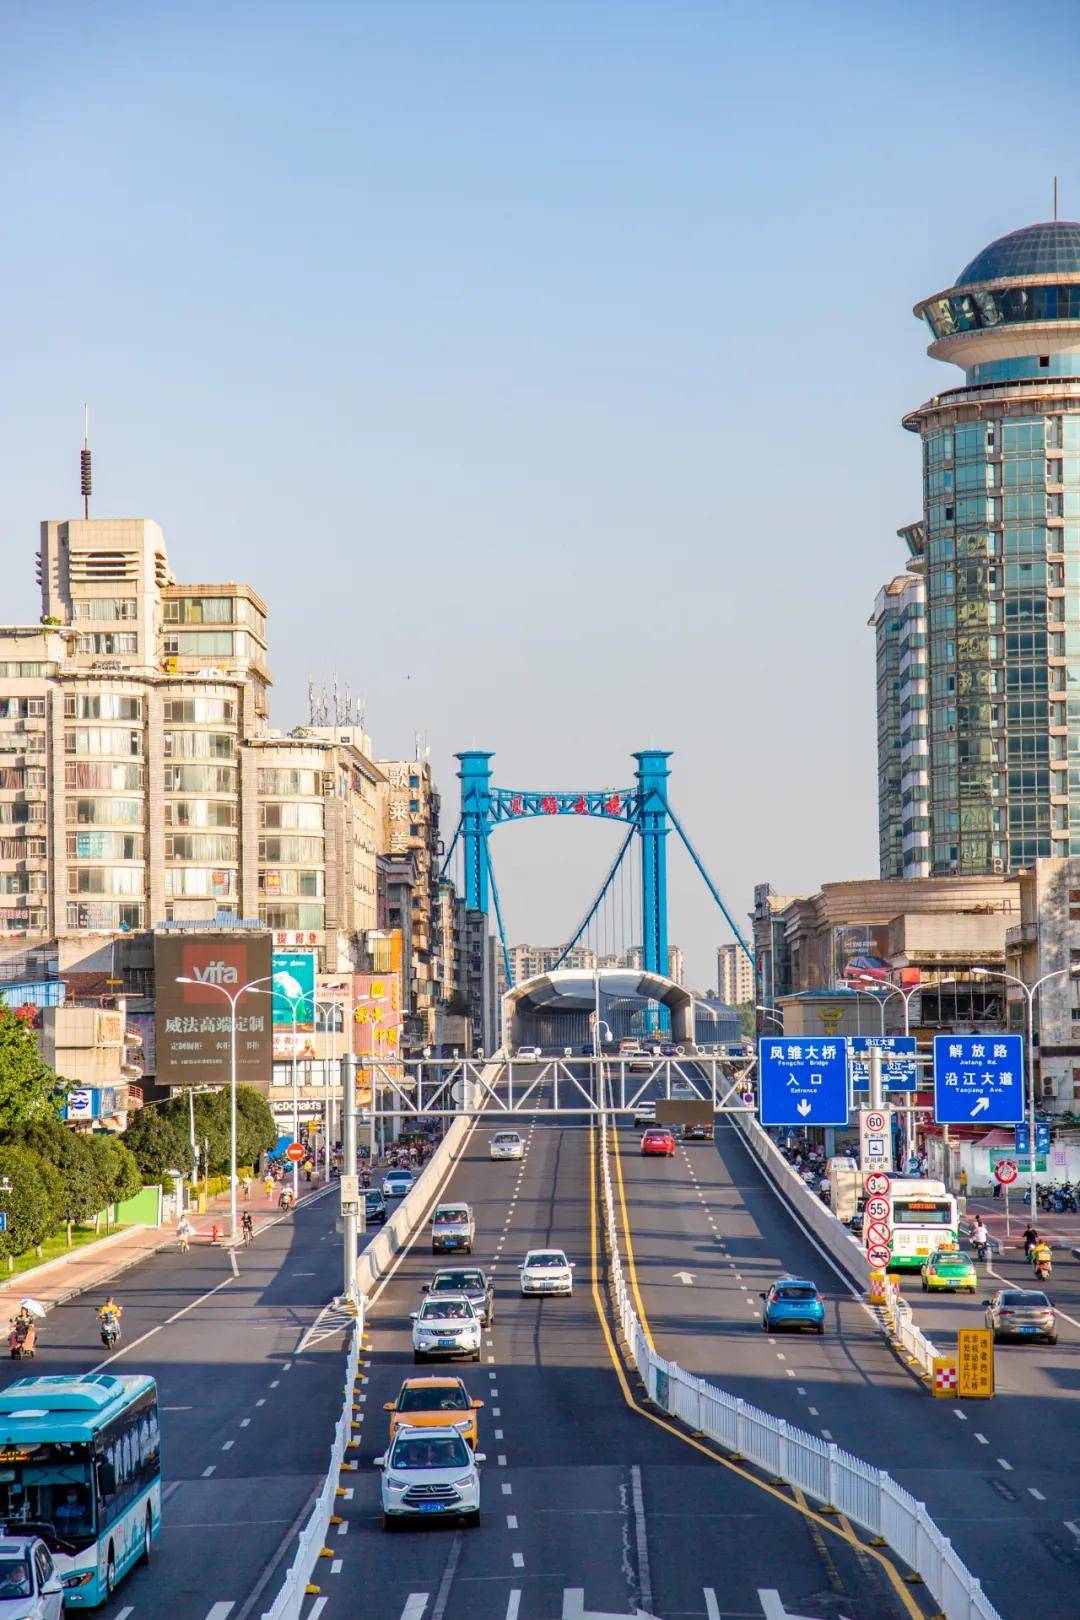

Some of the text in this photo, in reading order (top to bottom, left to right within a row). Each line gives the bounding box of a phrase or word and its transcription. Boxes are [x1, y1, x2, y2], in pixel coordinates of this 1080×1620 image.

[388, 767, 408, 853] 歌莱美
[192, 961, 238, 983] vifa
[165, 1016, 264, 1033] 威法高端定制
[865, 1038, 896, 1047] 沿江大道
[769, 1044, 837, 1060] 凤雏大桥
[949, 1043, 1008, 1058] 解放路
[786, 1072, 822, 1086] 入口
[945, 1072, 1014, 1086] 沿江大道
[869, 1117, 882, 1127] 60
[870, 1203, 886, 1215] 55t
